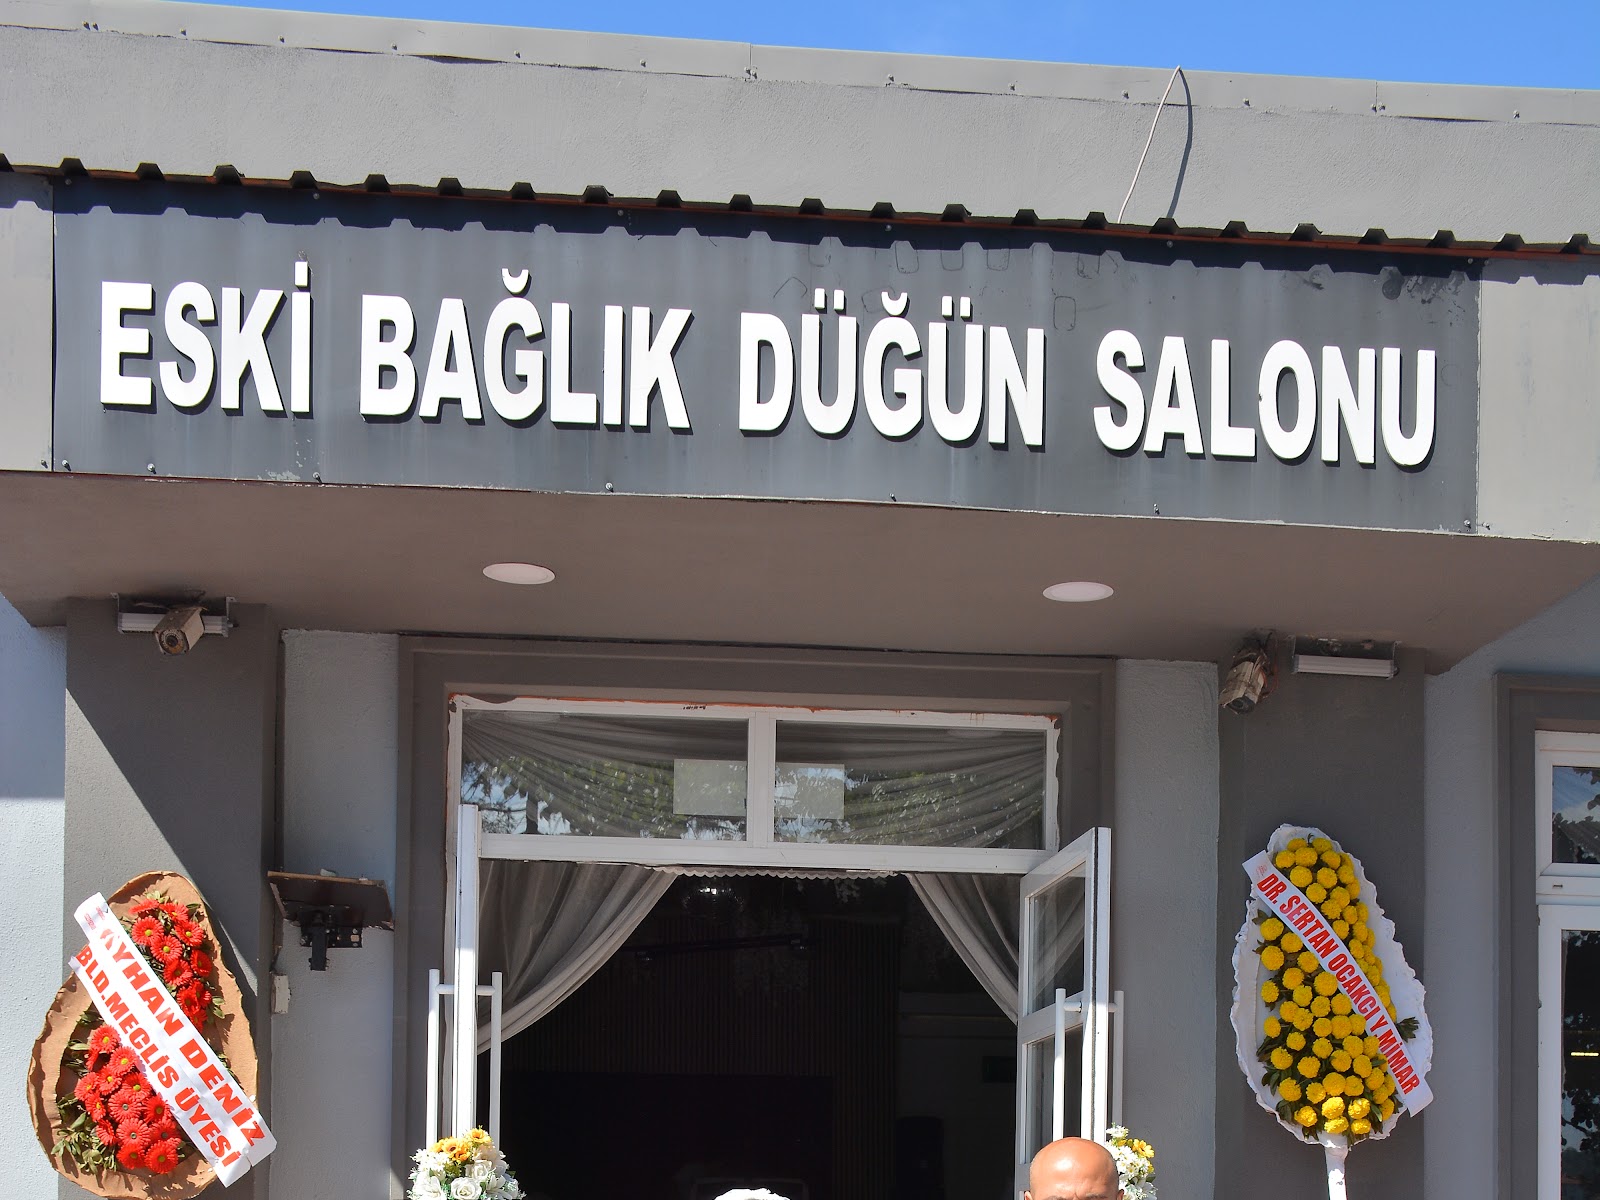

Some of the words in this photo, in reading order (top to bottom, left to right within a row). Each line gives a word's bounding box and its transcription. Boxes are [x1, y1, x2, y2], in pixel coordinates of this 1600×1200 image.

[101, 261, 310, 413] ESKİ
[359, 268, 692, 429] BAĞLIK
[739, 287, 1044, 447] DÜĞÜN
[1094, 330, 1436, 466] SALONU
[1257, 873, 1288, 904] DR.
[1279, 895, 1340, 959] SERTAN
[175, 1087, 243, 1168] ÜYESİ
[179, 1038, 266, 1147] DENİZ
